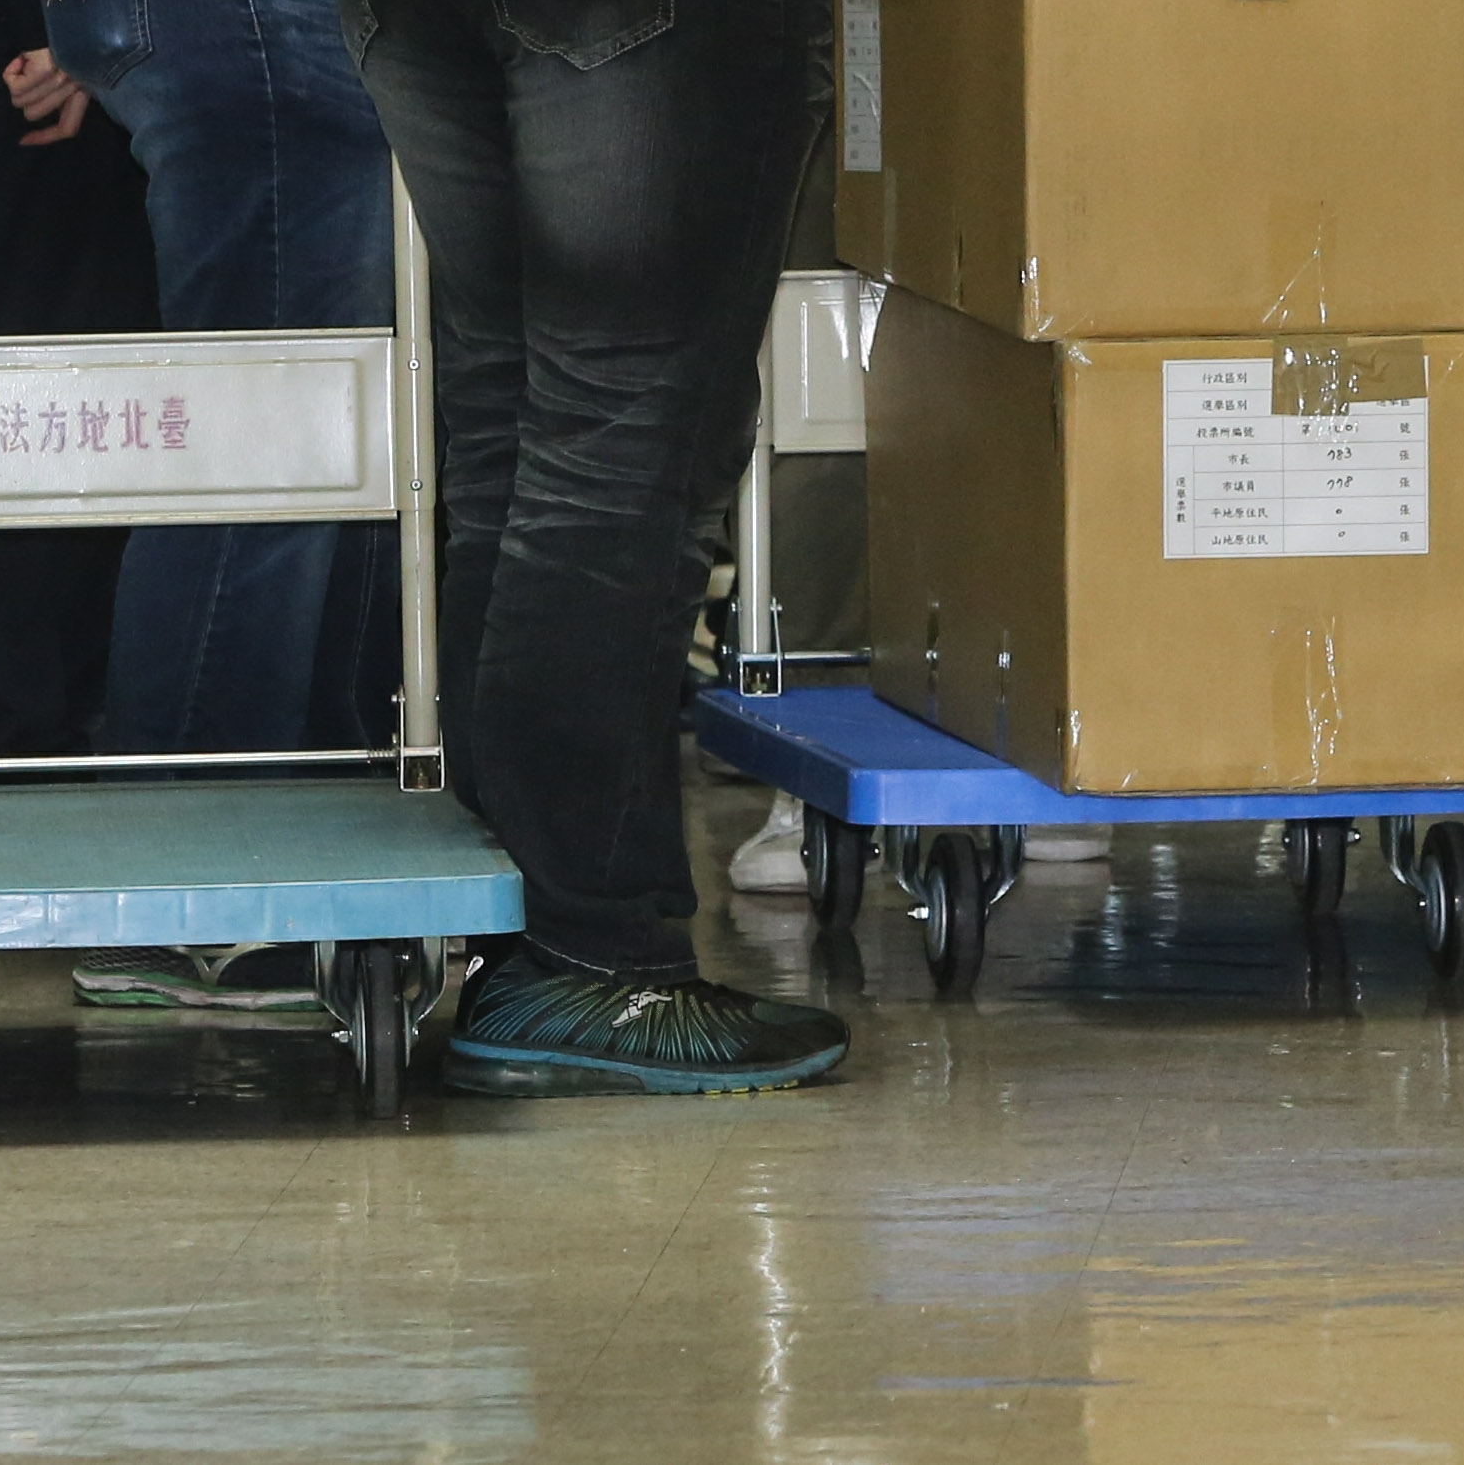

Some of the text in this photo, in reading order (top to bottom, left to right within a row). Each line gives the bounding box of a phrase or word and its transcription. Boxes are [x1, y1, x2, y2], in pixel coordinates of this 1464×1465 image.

[1202, 372, 1248, 385] 行政區別
[1201, 399, 1248, 412] 選舉區別
[1196, 426, 1255, 439] 投票所編號
[1399, 422, 1412, 434] 號
[1227, 453, 1250, 466] 市長
[1399, 449, 1410, 461] 張
[1222, 479, 1255, 493] 市議員
[1399, 476, 1411, 488] 張
[1175, 476, 1187, 524] 選舉票數
[1210, 507, 1269, 519] 平地原住民
[1399, 504, 1411, 516] 張
[1211, 533, 1269, 546] 山地原住民
[1399, 530, 1410, 543] 張
